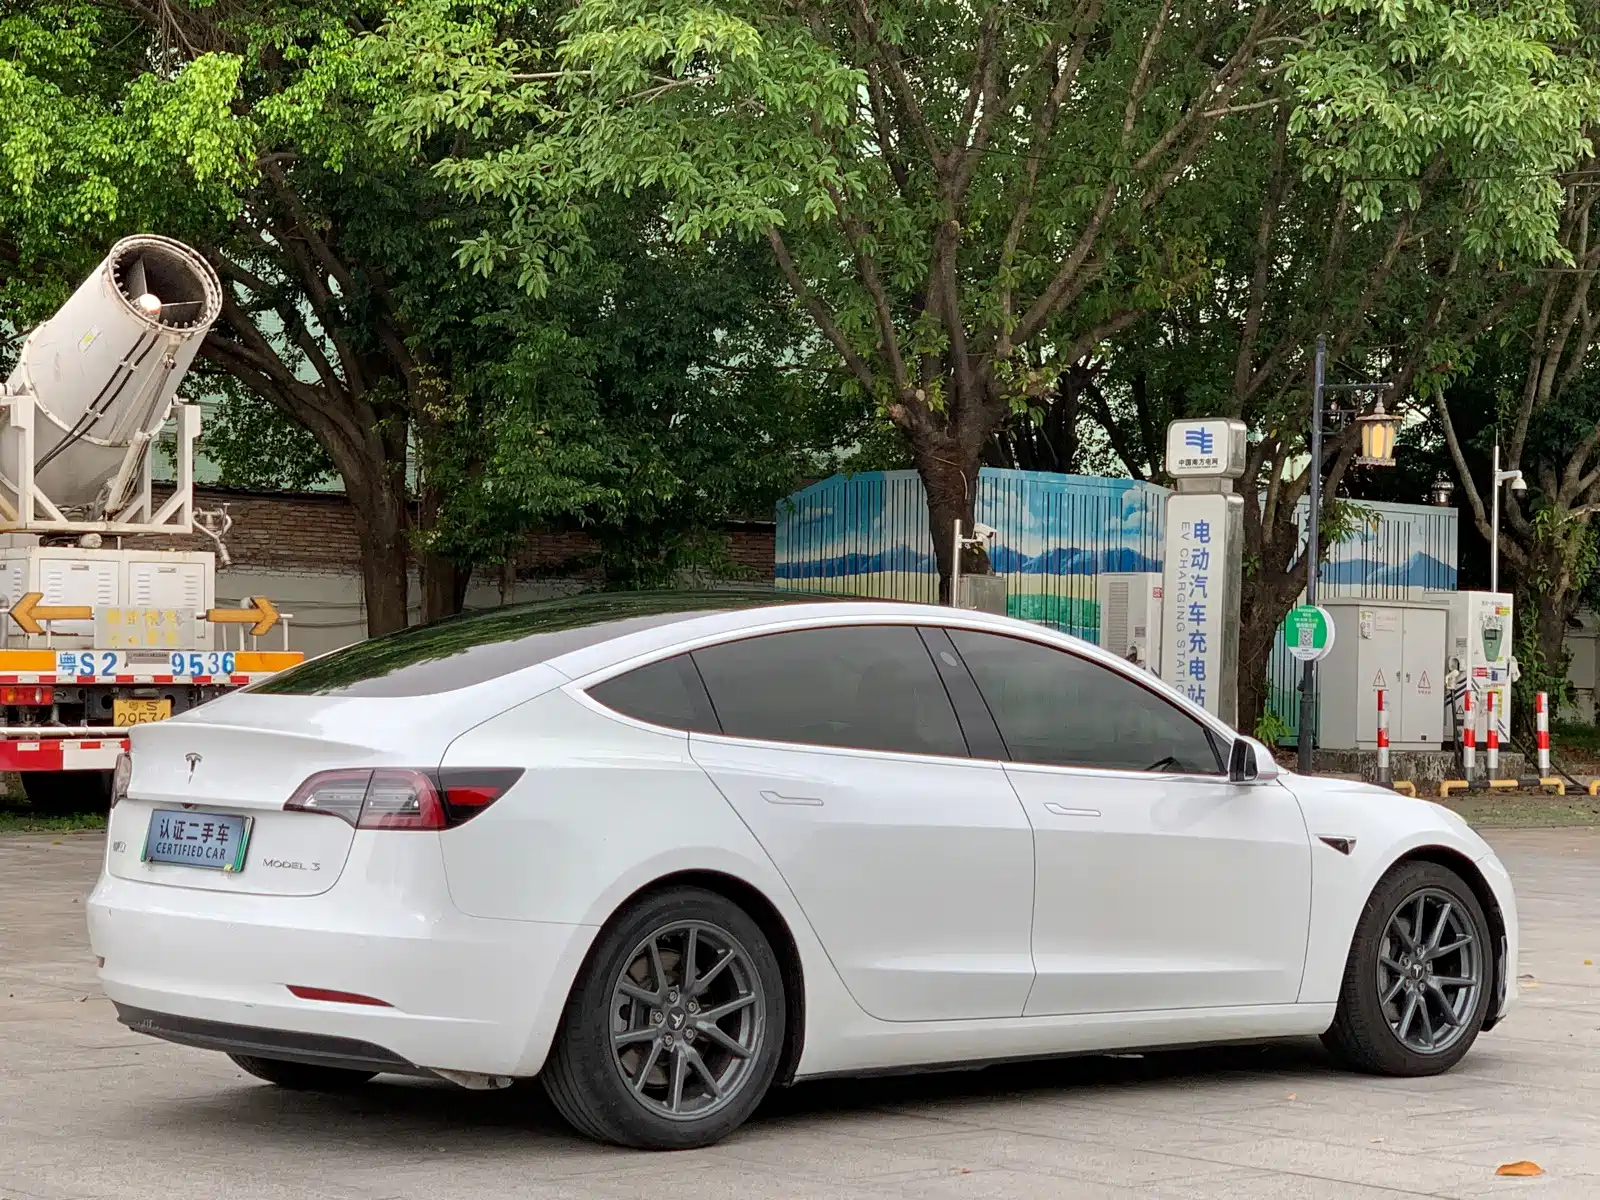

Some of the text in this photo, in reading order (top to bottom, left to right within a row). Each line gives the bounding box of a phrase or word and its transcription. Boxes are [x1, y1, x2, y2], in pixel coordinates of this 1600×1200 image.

[1178, 458, 1219, 466] 中国南方电网
[1181, 521, 1191, 541] EV
[1176, 548, 1189, 632] CHARGING
[1187, 519, 1211, 707] 电动汽车充电站
[160, 818, 230, 845] 认证二手车
[156, 842, 226, 860] CERTIFIED CAR
[263, 858, 321, 871] MODEL 3
